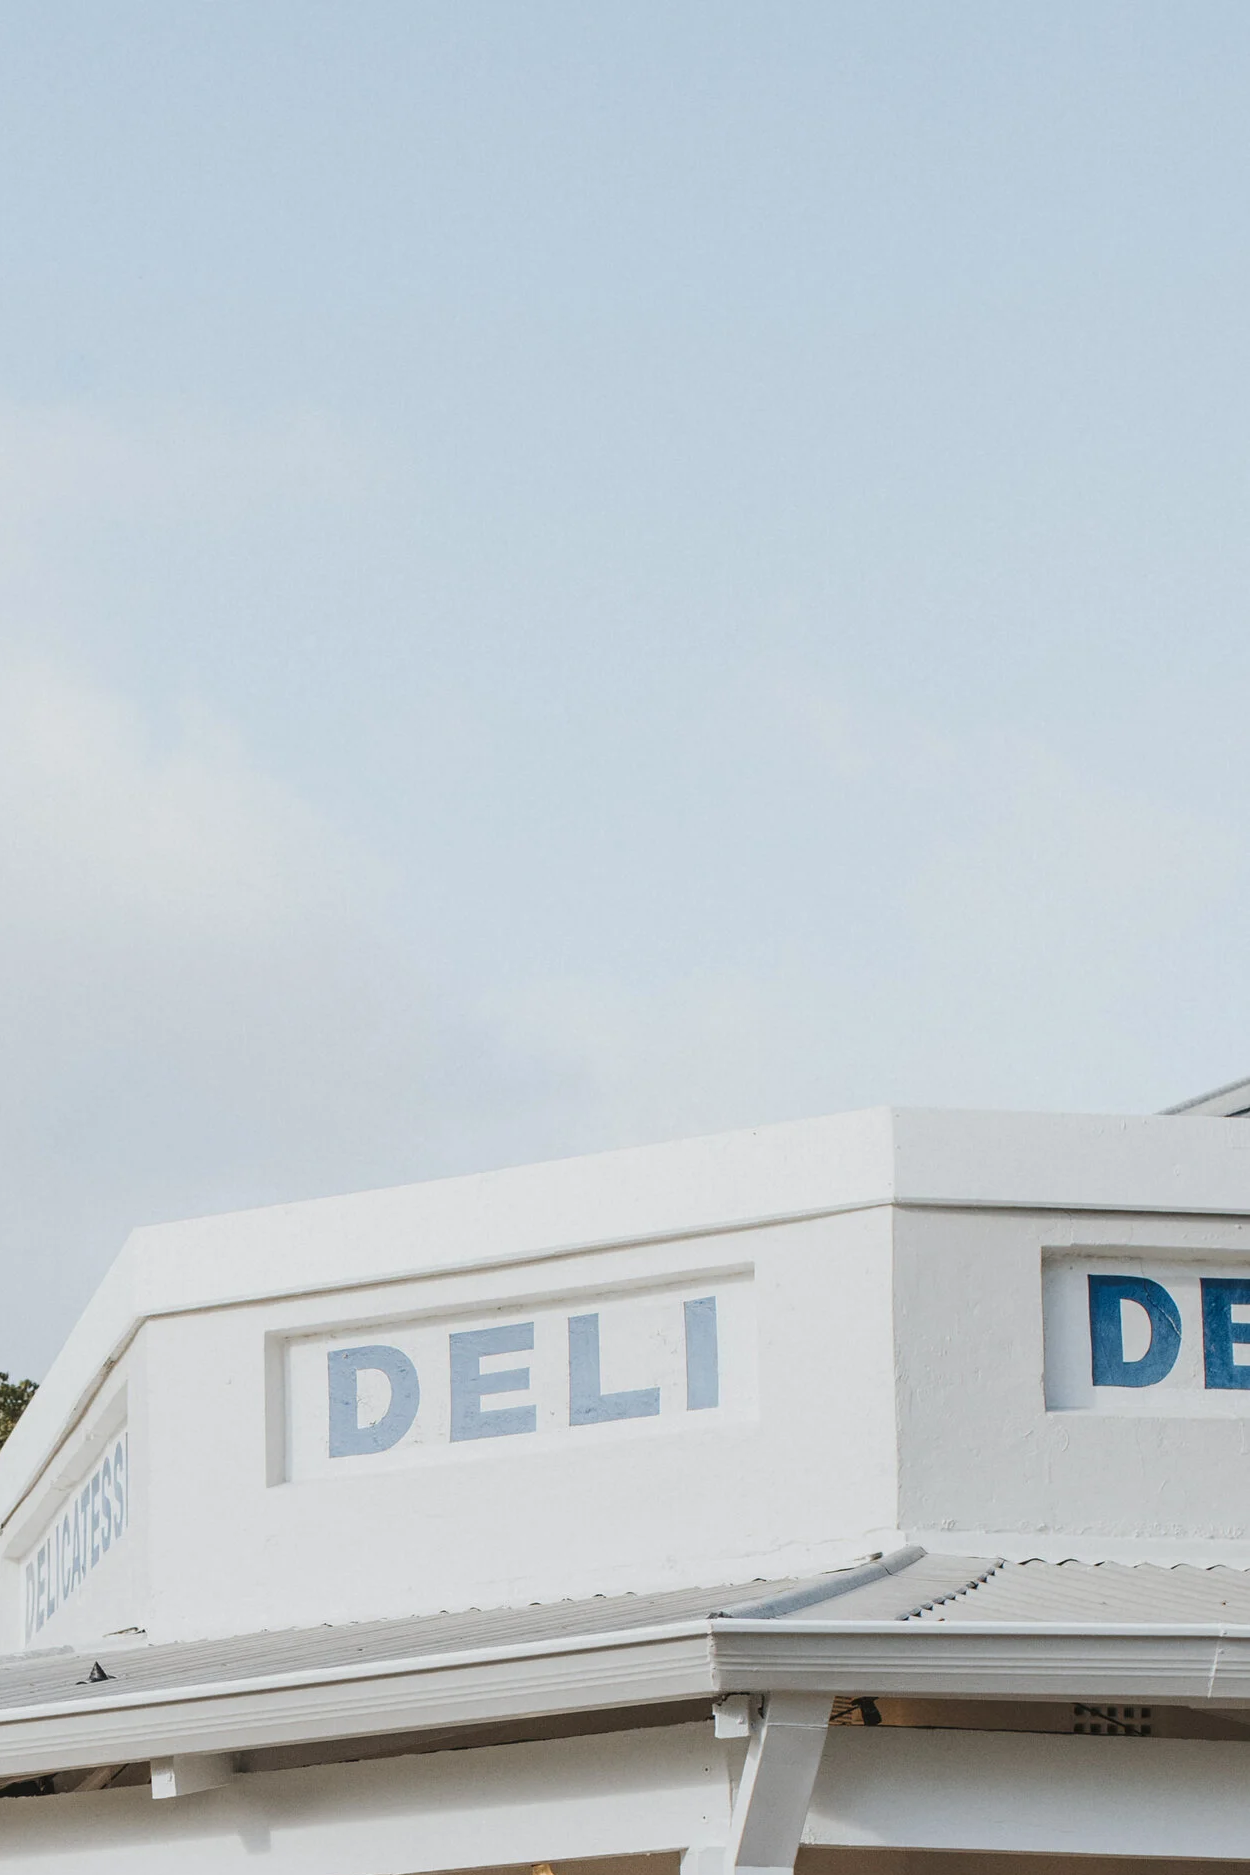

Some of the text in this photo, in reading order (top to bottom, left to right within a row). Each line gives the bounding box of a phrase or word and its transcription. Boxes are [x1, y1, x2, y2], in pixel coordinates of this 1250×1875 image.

[327, 1296, 720, 1458] DELI
[1087, 1274, 1250, 1390] DE
[25, 1432, 129, 1647] DELICATESS
